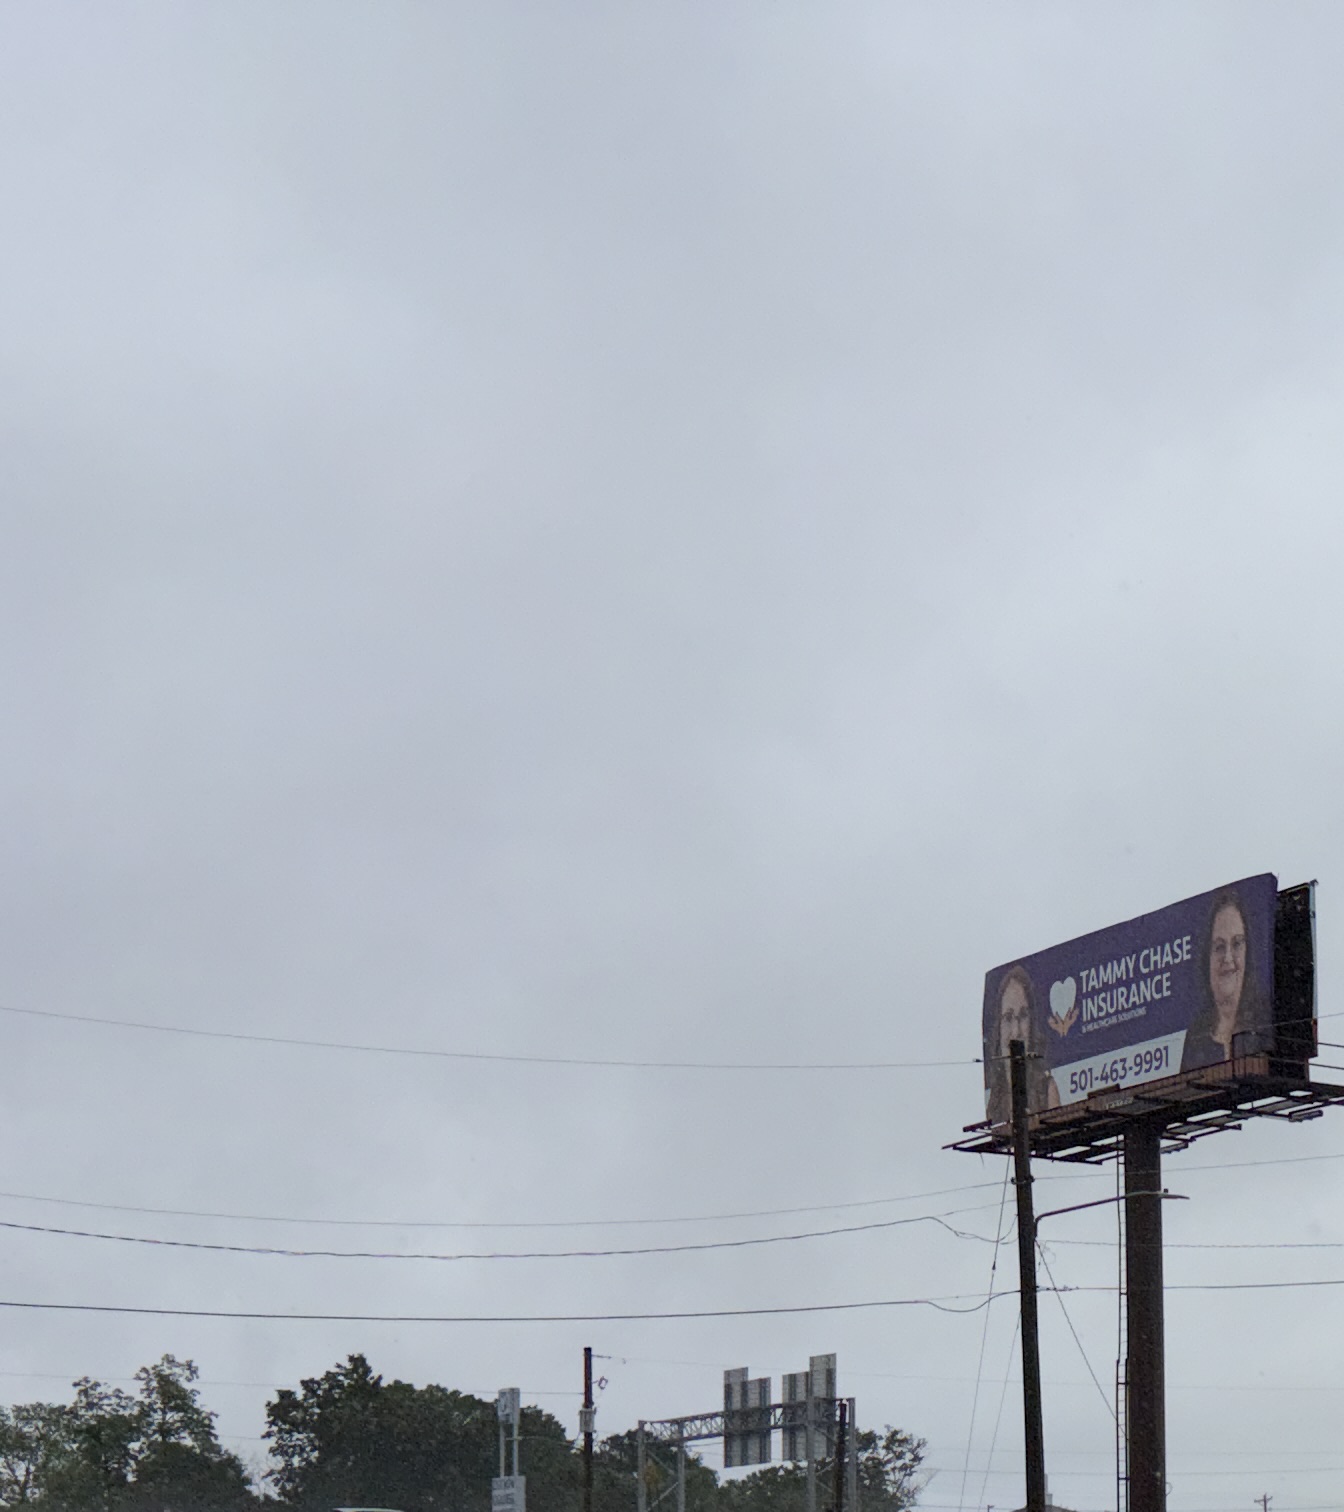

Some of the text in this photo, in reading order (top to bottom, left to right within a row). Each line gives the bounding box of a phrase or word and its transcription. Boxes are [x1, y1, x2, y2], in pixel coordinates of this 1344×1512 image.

[1080, 936, 1191, 993] TAMMY CHASE
[1082, 972, 1171, 1022] INSURANCE
